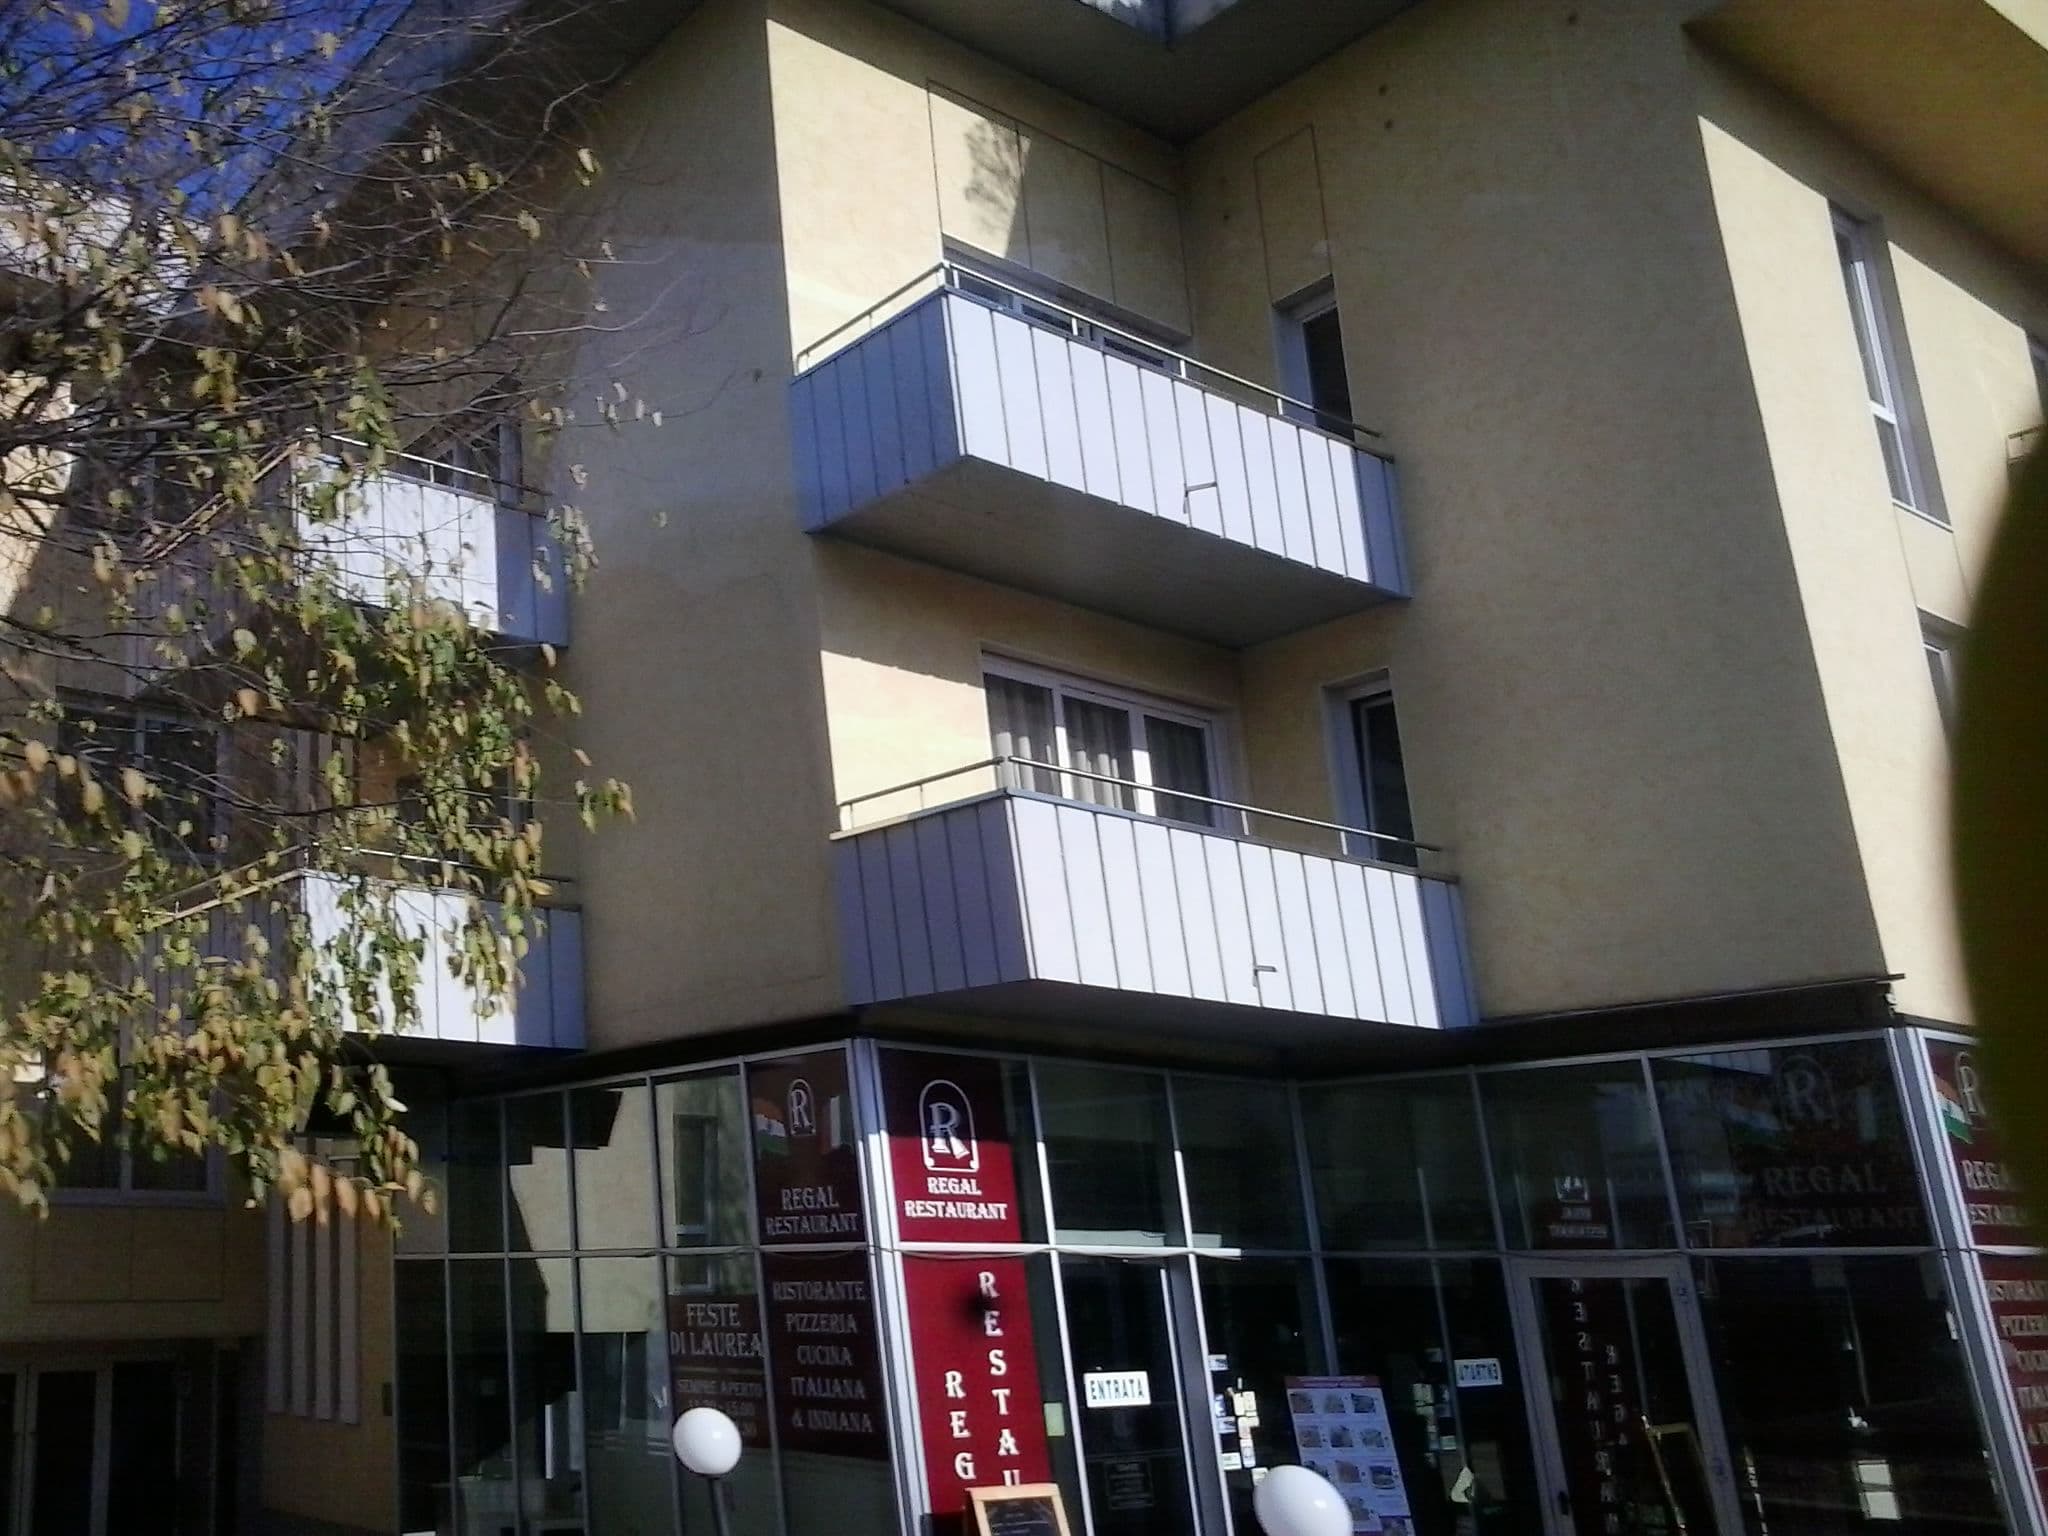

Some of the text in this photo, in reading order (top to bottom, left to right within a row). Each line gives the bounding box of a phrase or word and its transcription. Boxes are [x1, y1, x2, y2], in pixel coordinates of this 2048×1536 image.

[929, 1102, 971, 1160] R
[782, 1185, 840, 1210] REGAL
[927, 1177, 983, 1197] REGAL
[904, 1200, 1009, 1221] RESTAURANT
[766, 1213, 859, 1236] RESTAURANT
[772, 1281, 866, 1301] RISTORANTE
[686, 1303, 741, 1328] FESTE
[784, 1313, 858, 1334] PIZZERIA
[670, 1331, 766, 1359] DI LAUREA
[797, 1344, 854, 1367] CUCINA
[790, 1376, 866, 1400] ITALIANA
[1090, 1377, 1144, 1400] ENTRATA
[807, 1408, 874, 1433] INDIANA
